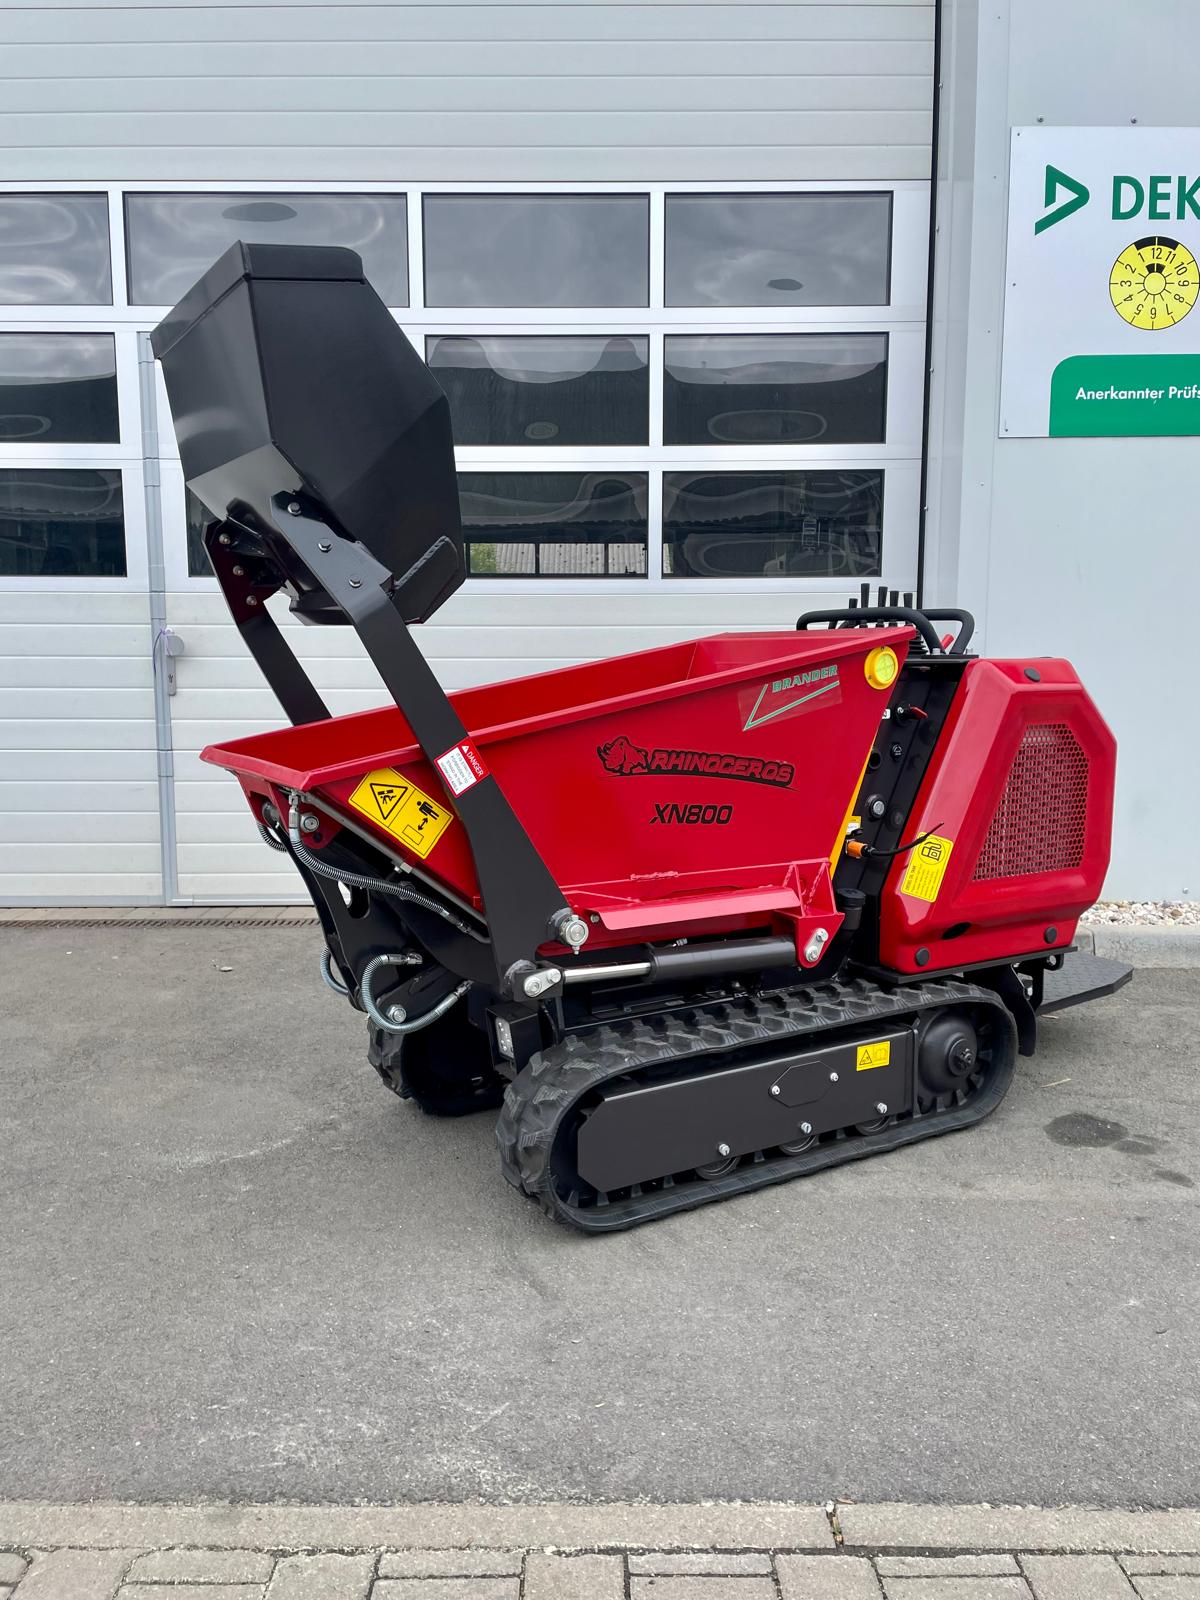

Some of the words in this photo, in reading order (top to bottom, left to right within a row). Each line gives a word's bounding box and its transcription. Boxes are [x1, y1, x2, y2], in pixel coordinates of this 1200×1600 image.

[1111, 175, 1200, 220] DEK
[1138, 252, 1145, 262] 1
[1152, 248, 1162, 260] 12
[1164, 250, 1176, 264] 11
[1124, 264, 1136, 274] 2
[1174, 262, 1188, 276] 10
[1123, 294, 1134, 302] 4
[1174, 294, 1184, 303] 8
[1134, 304, 1144, 316] 5
[1166, 303, 1173, 315] 7
[1075, 386, 1166, 400] Anerkannter
[771, 664, 838, 693] BRANDER
[466, 751, 484, 776] DANGER
[651, 750, 795, 785] RHINOCEROS
[649, 803, 733, 824] XN800
